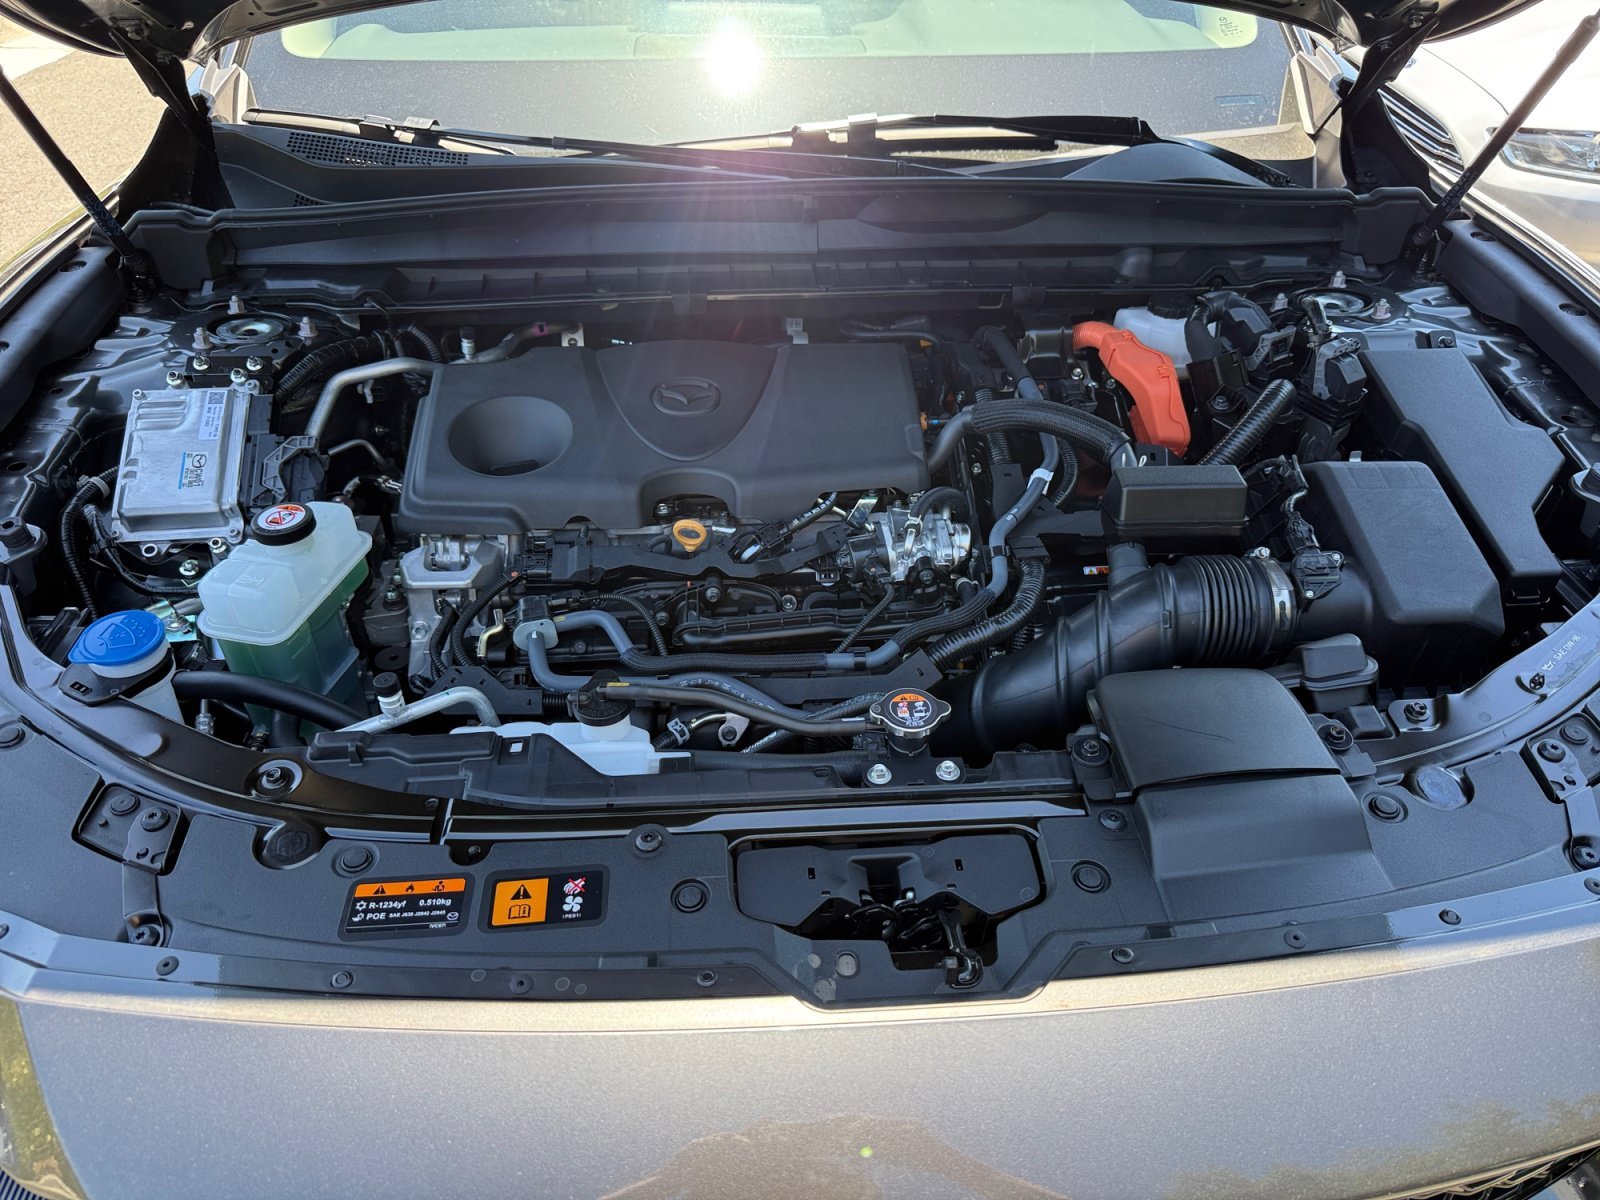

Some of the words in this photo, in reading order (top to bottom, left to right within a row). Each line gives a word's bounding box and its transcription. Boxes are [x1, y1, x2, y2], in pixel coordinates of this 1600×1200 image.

[1553, 648, 1568, 661] SAE
[368, 900, 407, 910] R-1234yf
[419, 898, 452, 907] 0.510kg
[366, 912, 386, 920] POE
